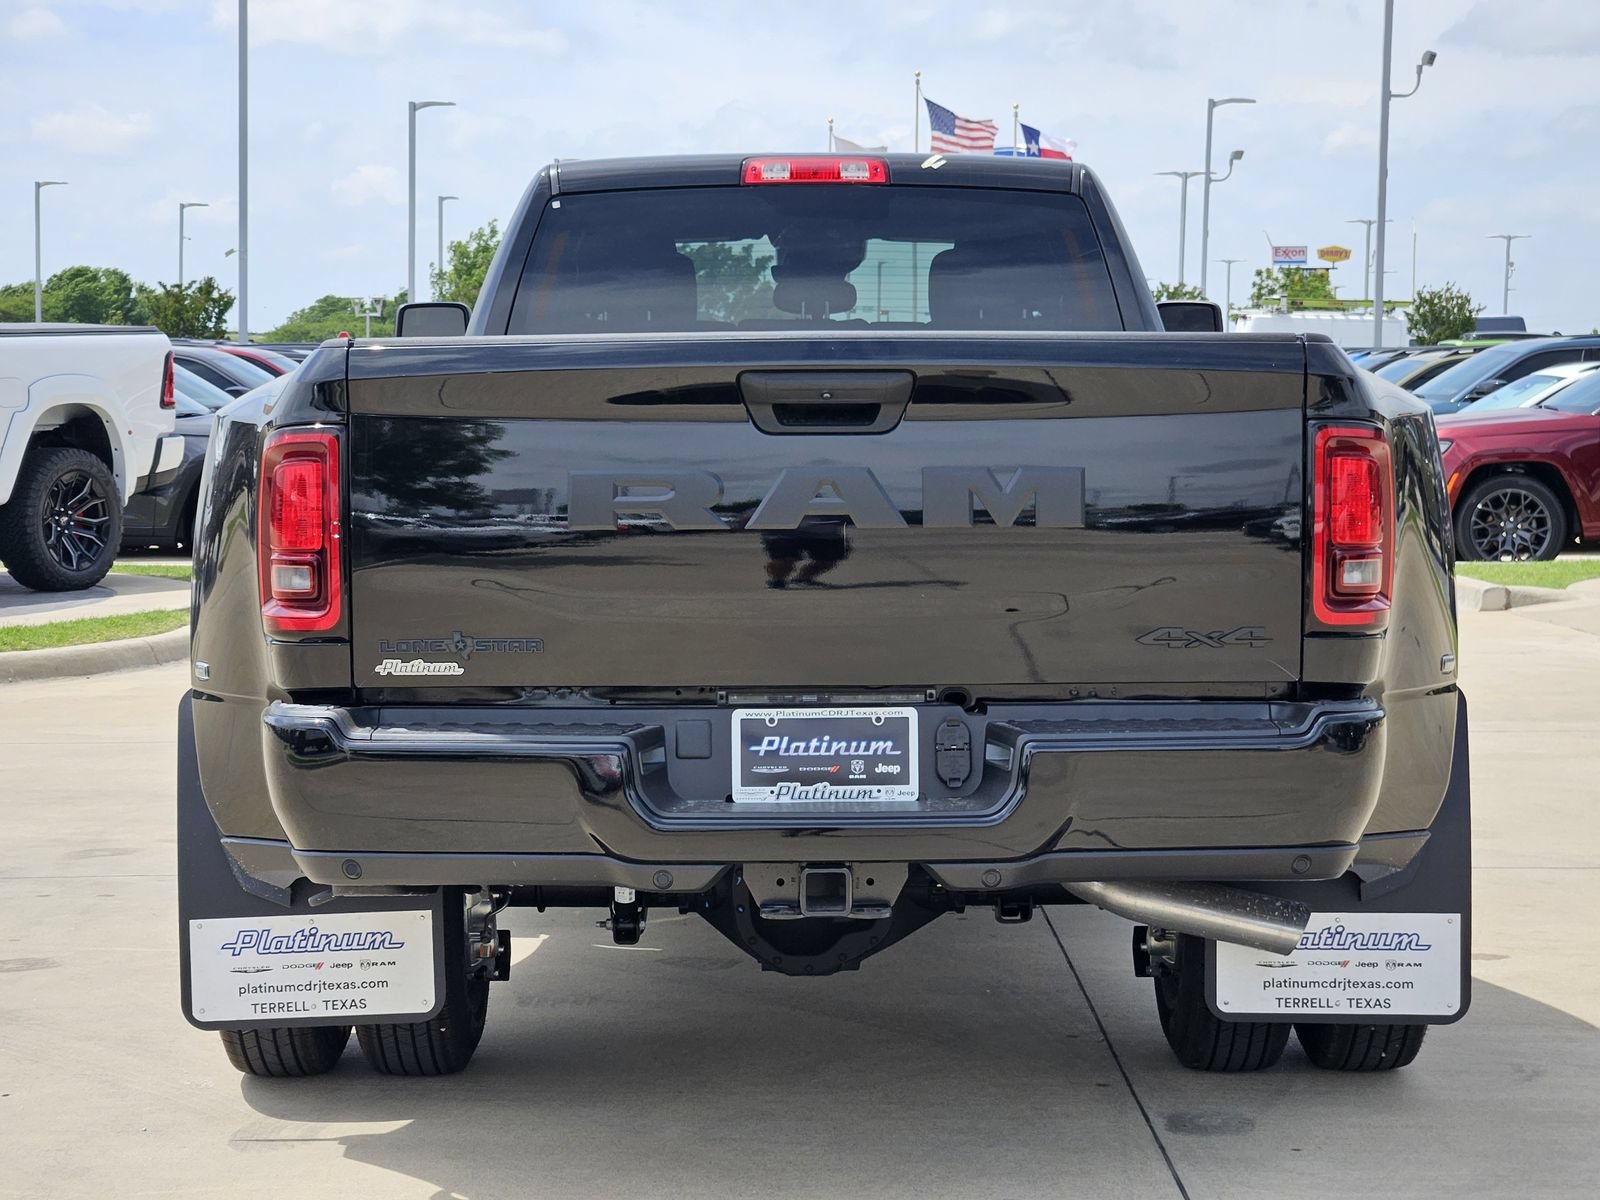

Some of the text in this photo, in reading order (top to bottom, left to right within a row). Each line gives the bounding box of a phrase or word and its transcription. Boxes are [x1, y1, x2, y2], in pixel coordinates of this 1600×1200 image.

[1274, 247, 1305, 259] Exxon
[567, 465, 1086, 530] RAM
[378, 638, 544, 654] LONE STAR
[375, 659, 464, 675] Platinum
[745, 709, 904, 718] www.PlatinumCDRJTexas.com
[749, 735, 902, 757] Platinum
[875, 763, 901, 775] Jeep
[776, 785, 880, 800] Platinum
[220, 926, 405, 957] Platinum
[1296, 925, 1432, 951] atinum
[329, 961, 354, 969] Jeep
[238, 979, 390, 997] platinumcdrjtexas.com
[1263, 978, 1414, 992] platinumcdrjtexas.com
[322, 998, 368, 1011] TEXAS
[1346, 998, 1391, 1009] TEXAS
